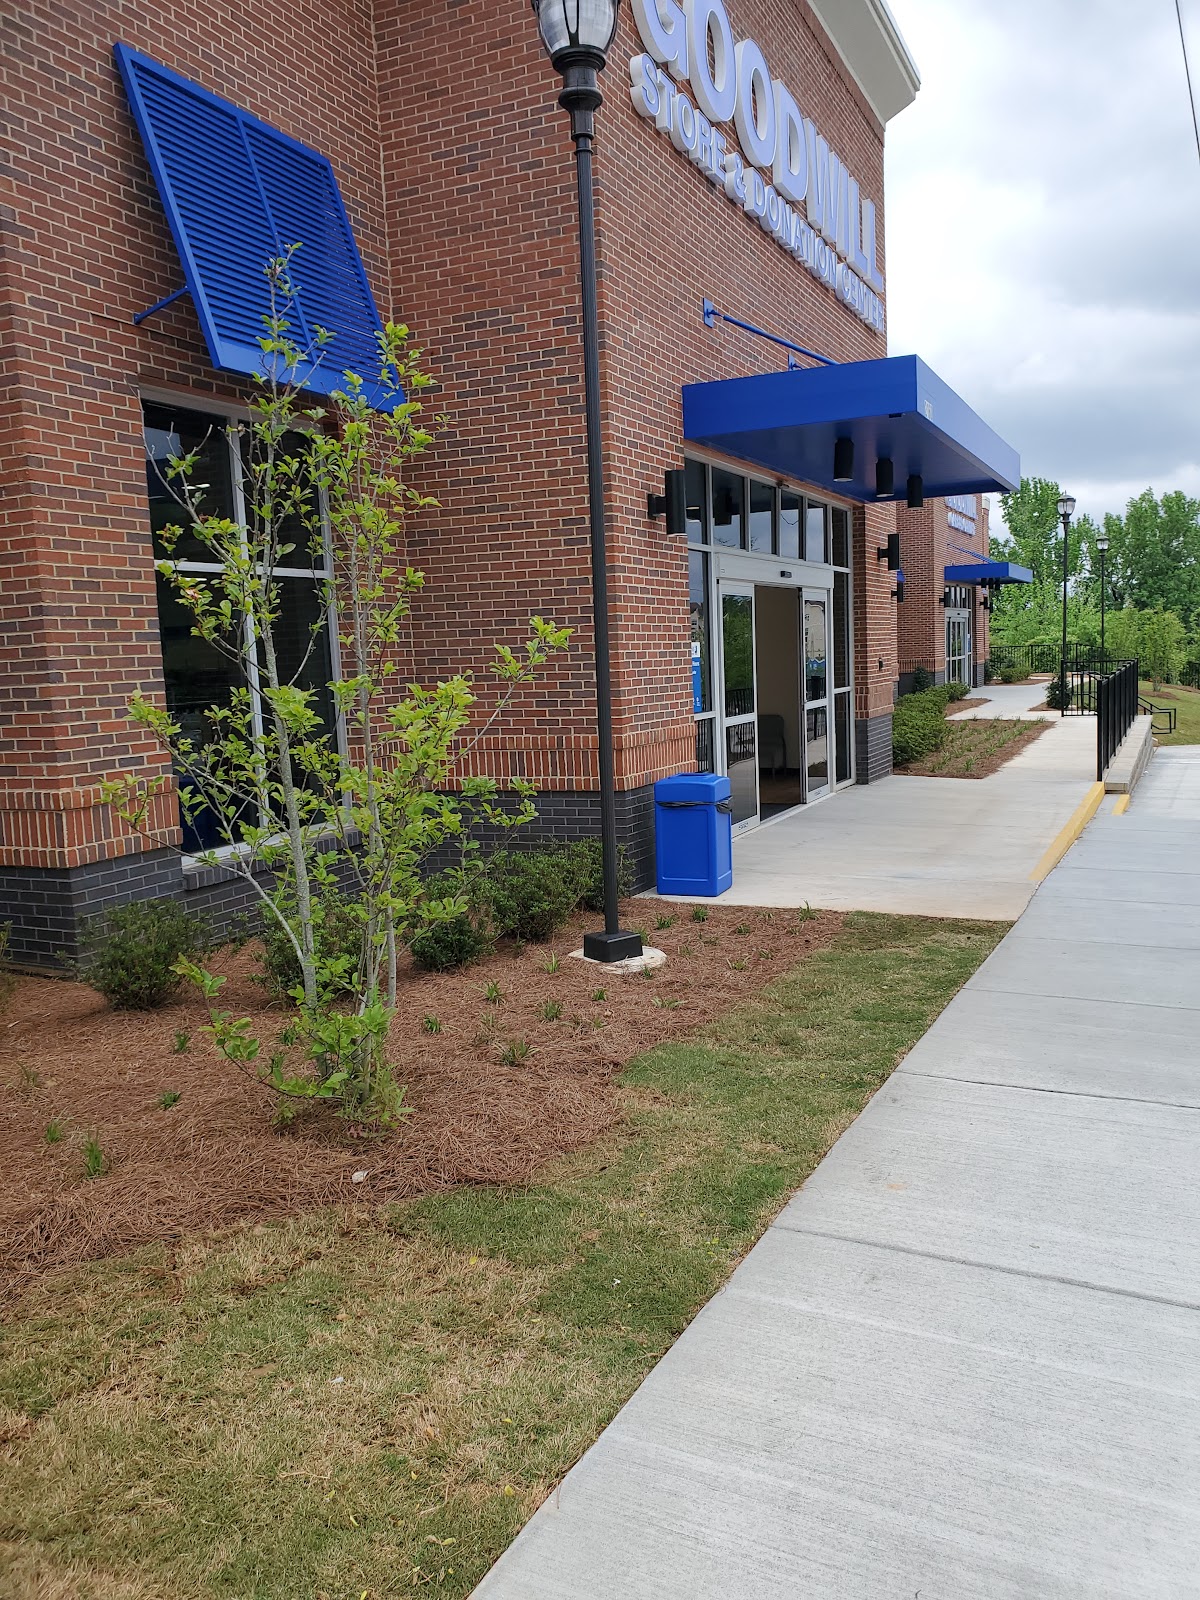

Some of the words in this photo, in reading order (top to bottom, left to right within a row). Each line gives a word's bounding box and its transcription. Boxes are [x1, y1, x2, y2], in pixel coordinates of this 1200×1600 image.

[630, 53, 727, 185] STORE
[724, 152, 747, 203] &
[743, 167, 837, 289] DONATION
[836, 263, 884, 334] CENTER
